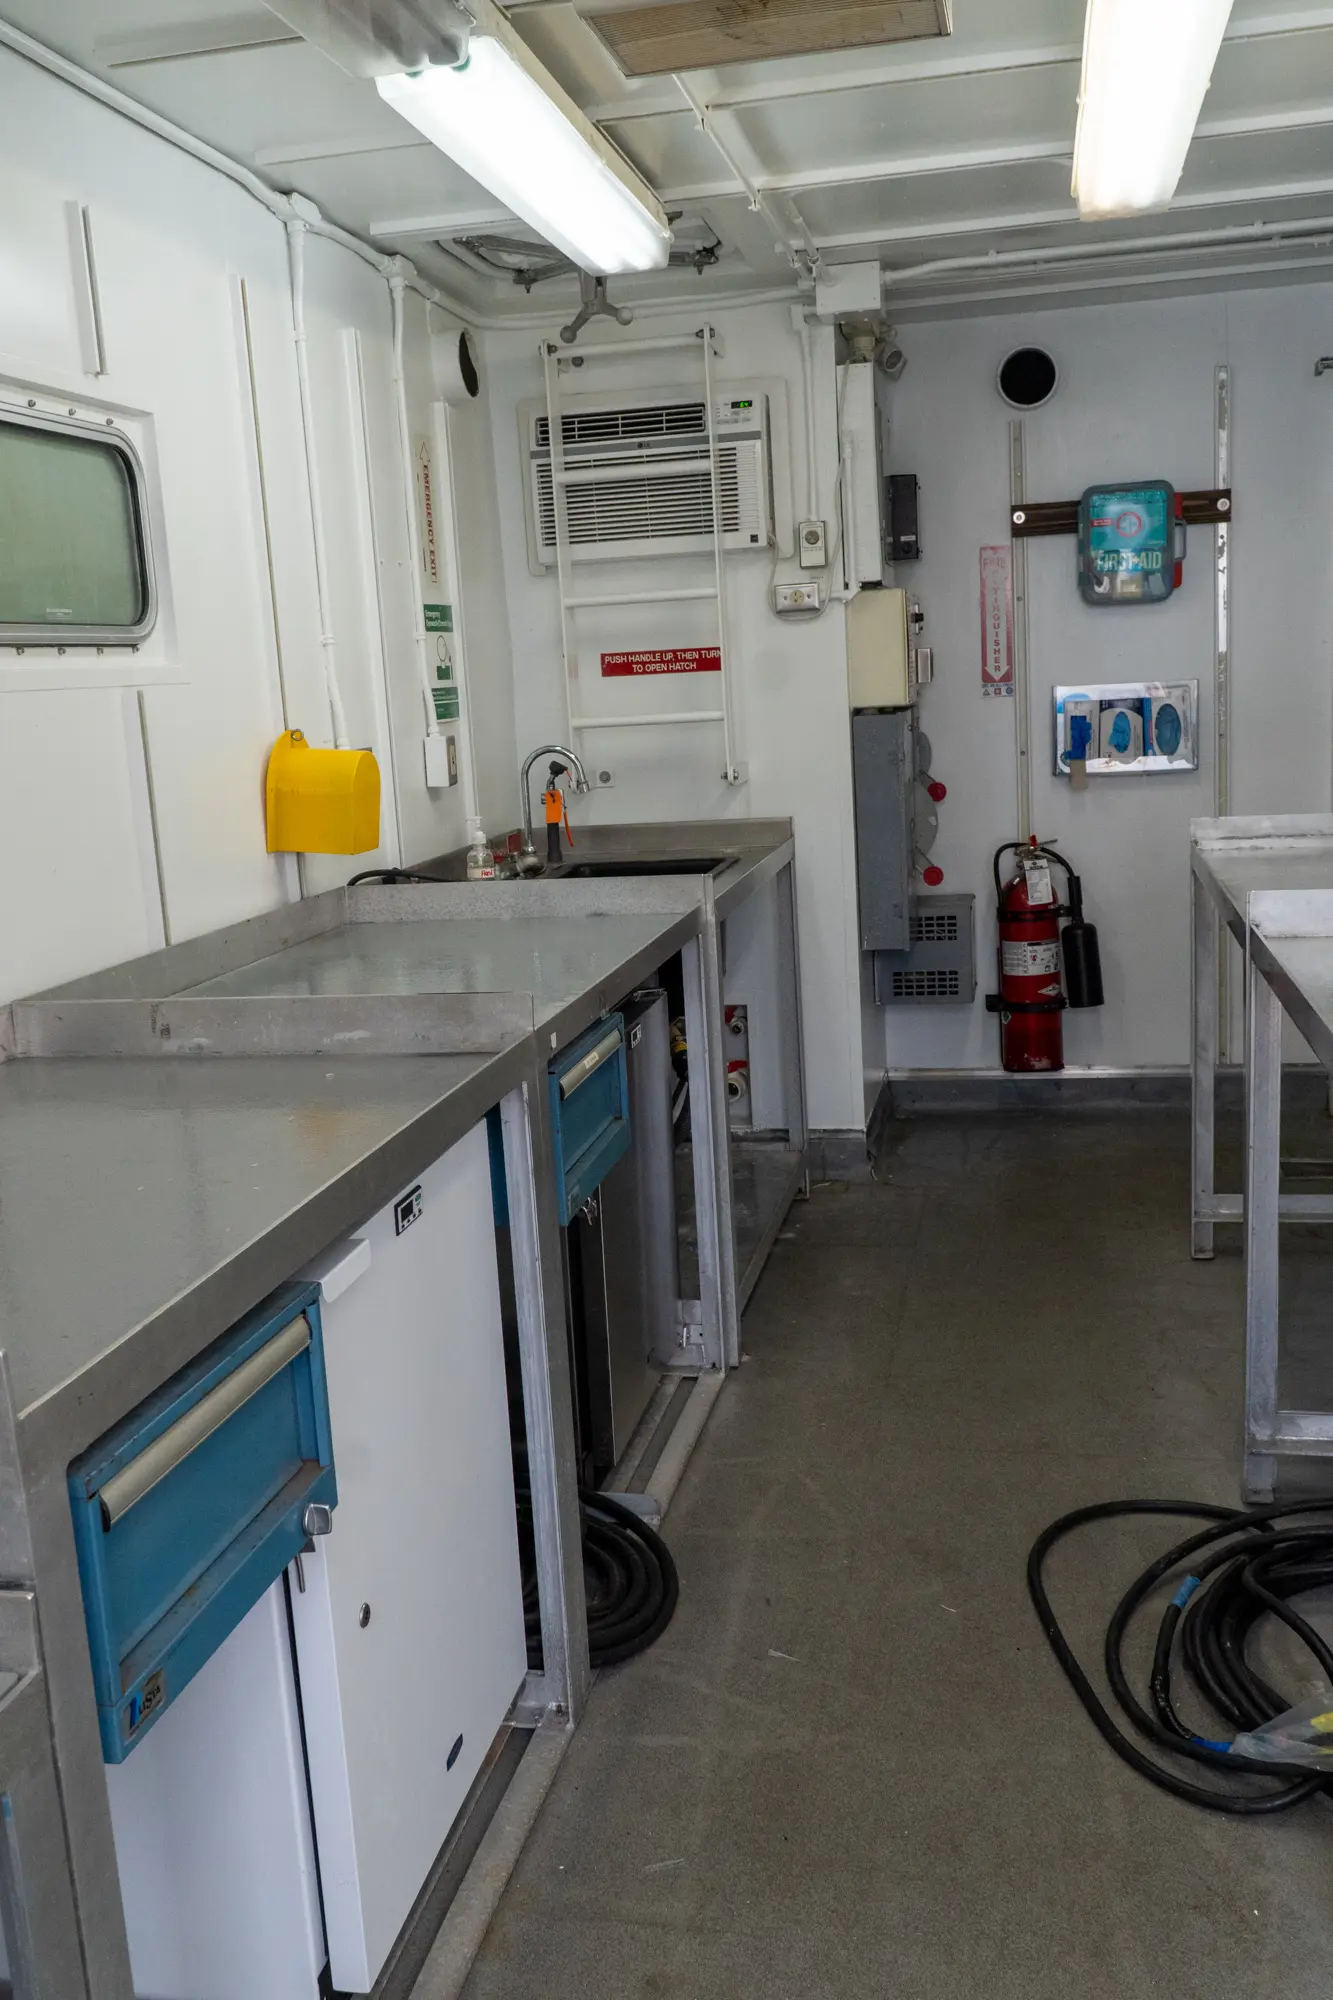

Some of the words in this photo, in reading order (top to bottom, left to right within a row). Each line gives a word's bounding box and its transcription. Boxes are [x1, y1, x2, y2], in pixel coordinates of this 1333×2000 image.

[429, 550, 437, 579] EXIT
[1140, 551, 1162, 570] AID
[604, 654, 627, 664] PUSH
[628, 652, 661, 663] HANDLE
[676, 650, 699, 660] THEN
[700, 649, 721, 659] TURN
[632, 664, 643, 673] TO
[645, 663, 668, 672] OPEN
[669, 661, 697, 671] HATCH
